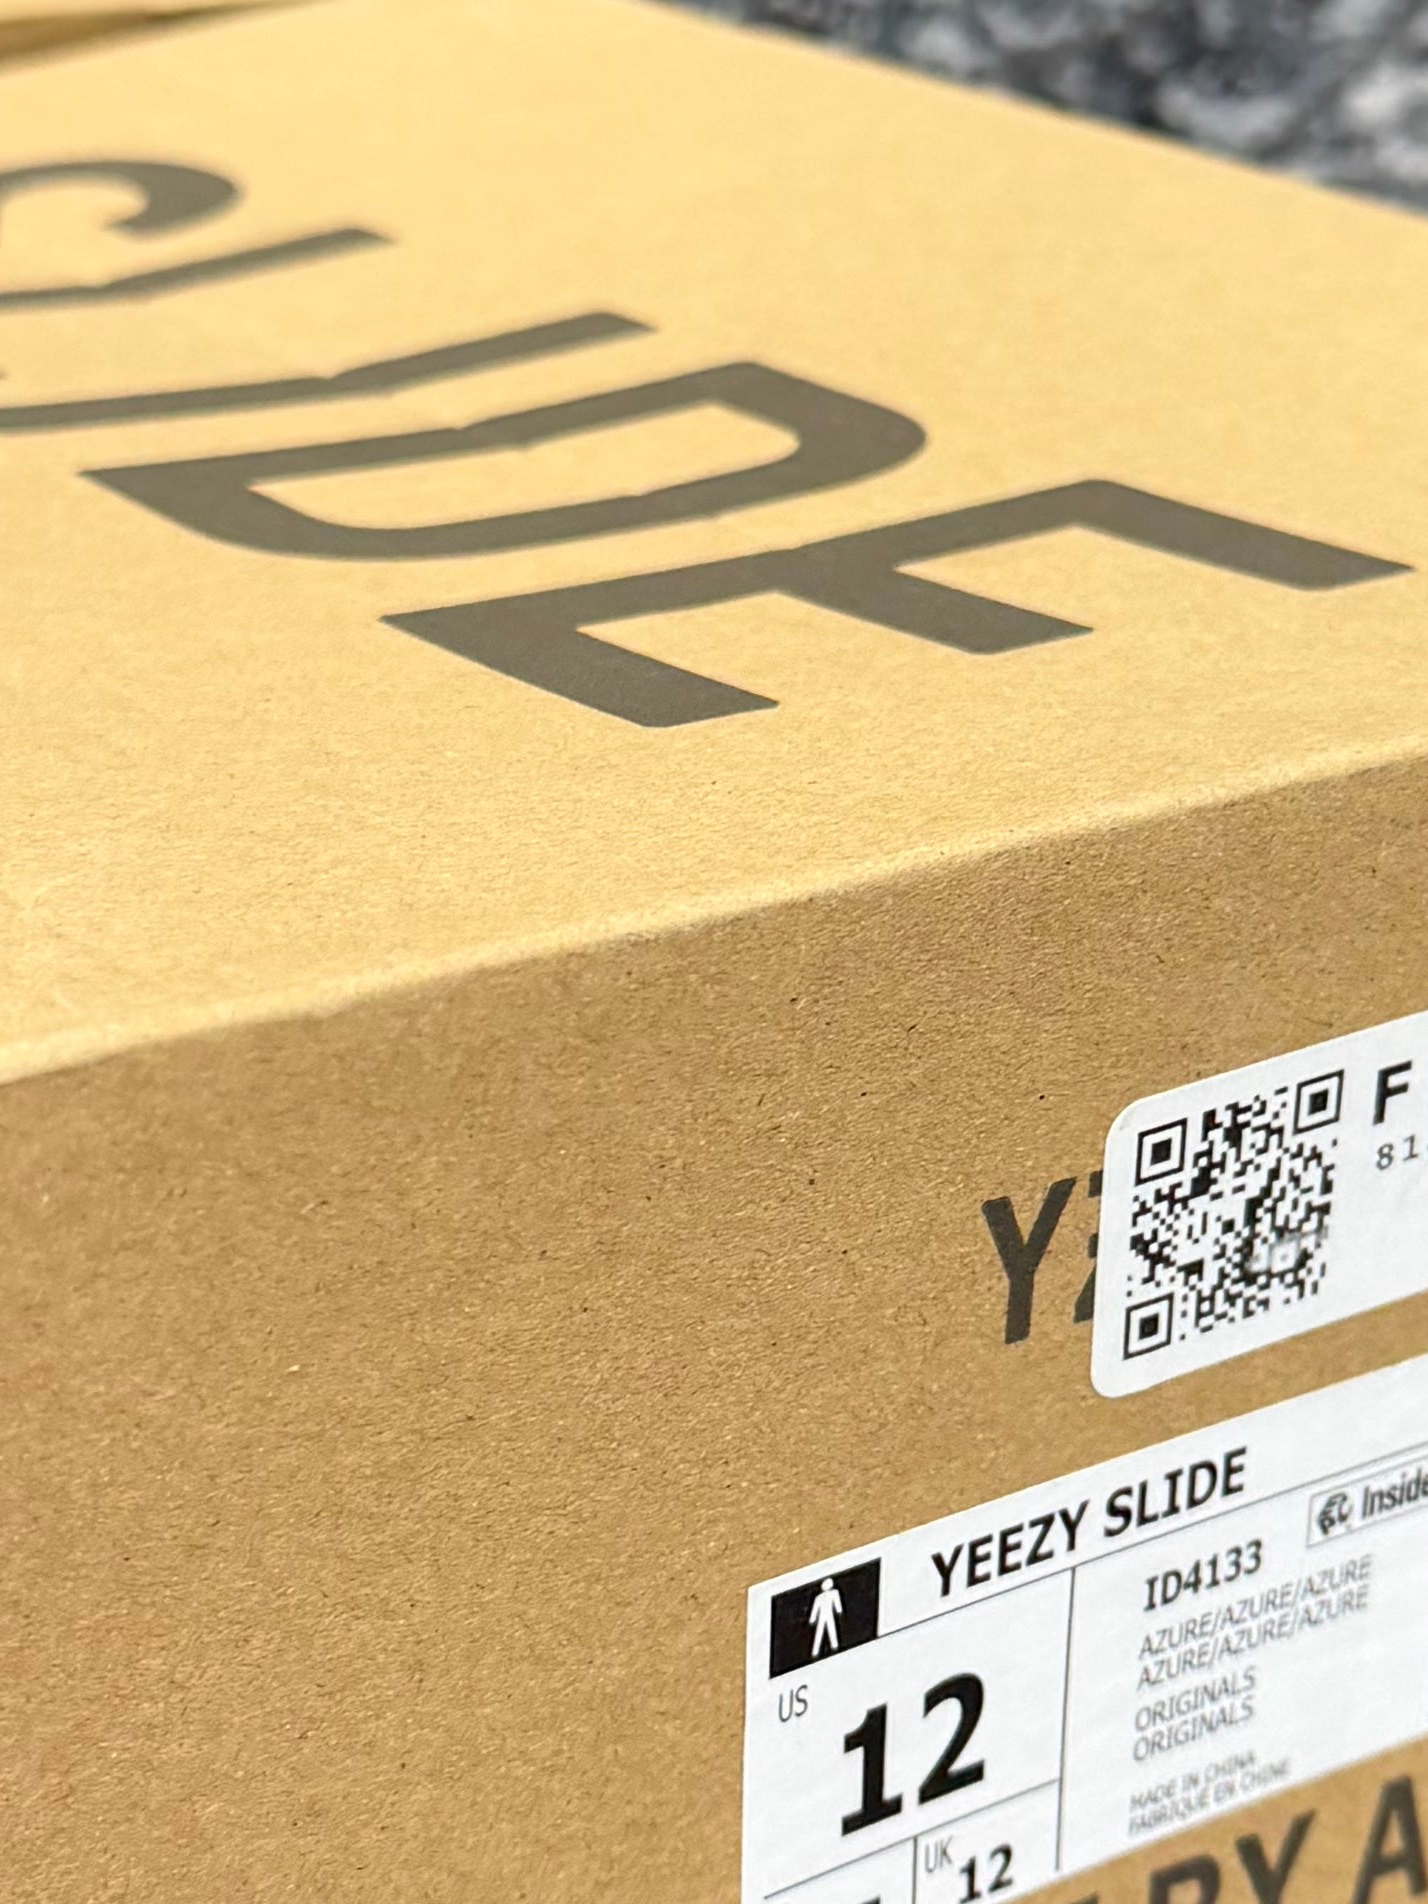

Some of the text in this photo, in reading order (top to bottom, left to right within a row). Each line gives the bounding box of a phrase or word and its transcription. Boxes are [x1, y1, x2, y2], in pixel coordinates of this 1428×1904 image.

[930, 1445, 1248, 1598] YEEZY SLIDE
[1138, 1552, 1375, 1662] AZURE/AZURE/AZURE
[1142, 1537, 1264, 1613] ID4133
[1136, 1582, 1372, 1692] AZURE/AZURE/AZURE
[777, 1684, 809, 1724] US
[1131, 1696, 1255, 1763] ORIGINALS
[1133, 1665, 1257, 1733] ORIGINALS
[840, 1671, 986, 1837] 12
[923, 1835, 954, 1875] UK
